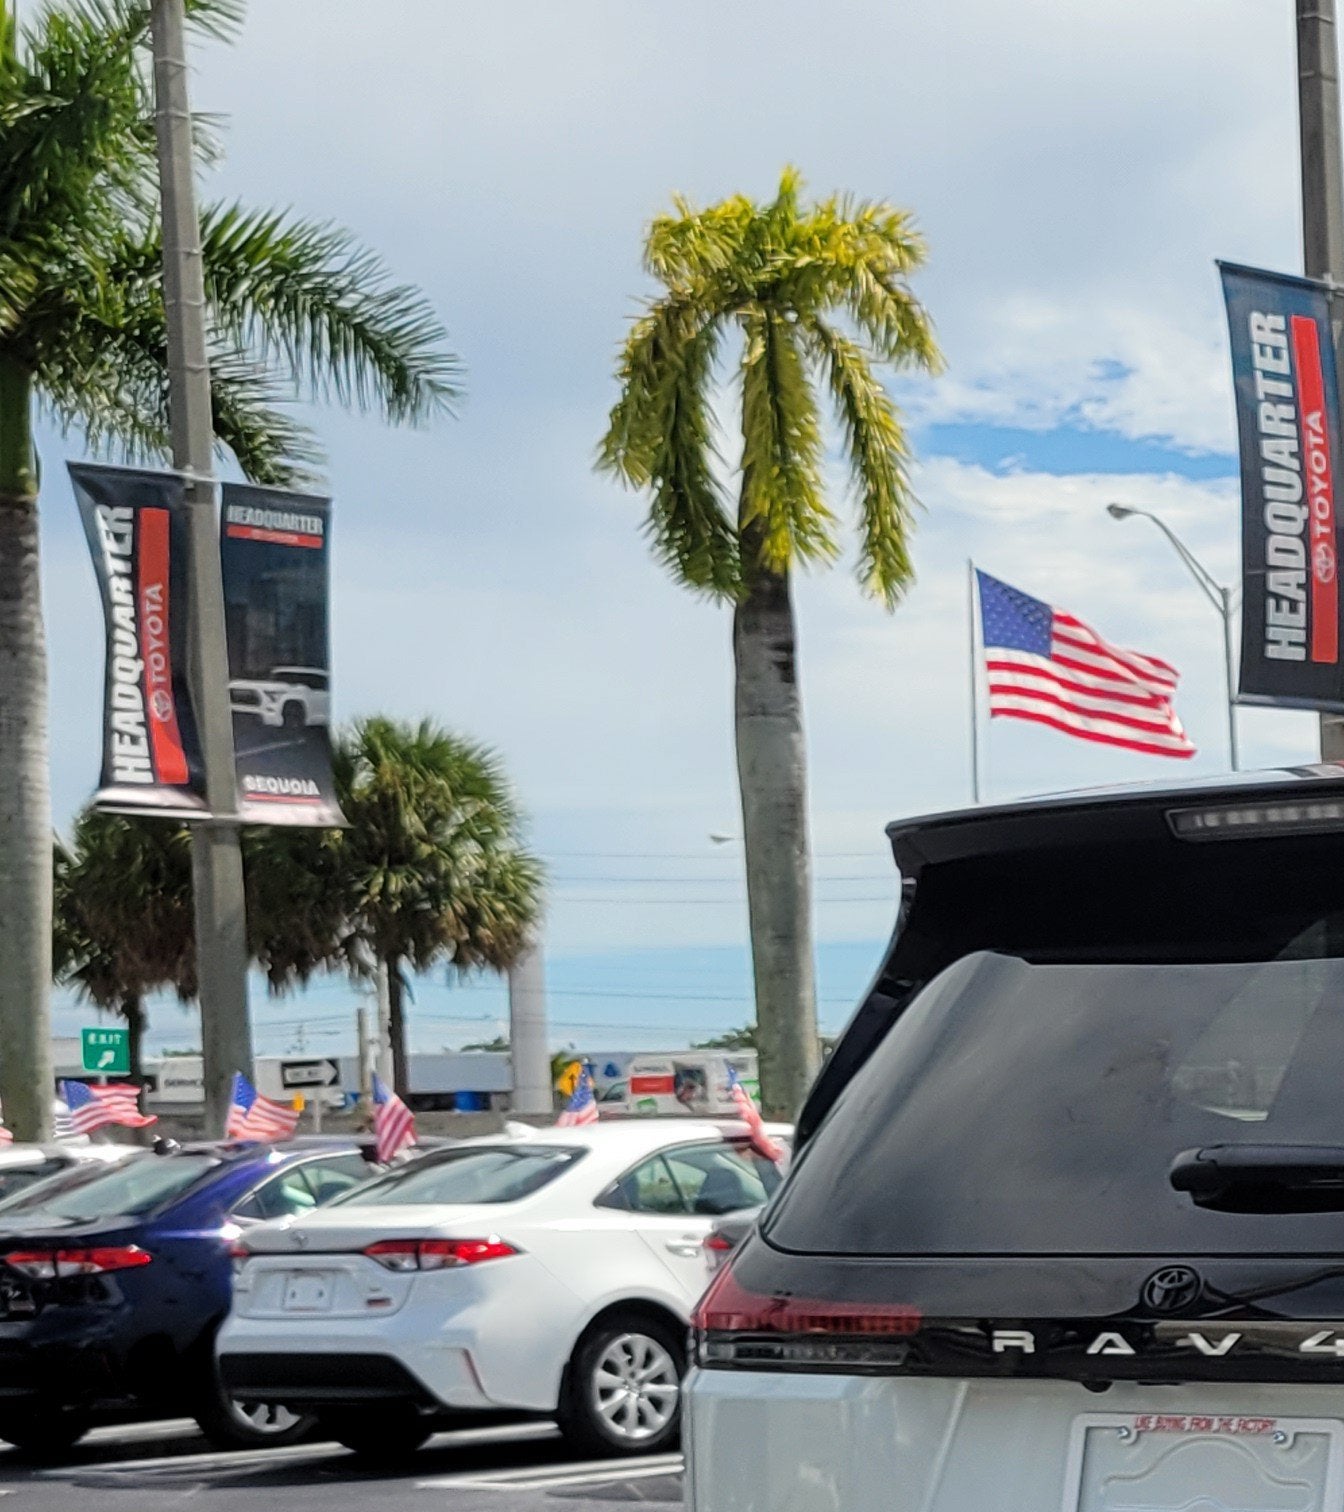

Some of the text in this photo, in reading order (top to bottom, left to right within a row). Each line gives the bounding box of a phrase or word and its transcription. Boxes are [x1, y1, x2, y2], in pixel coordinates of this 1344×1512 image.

[226, 504, 324, 535] HEADQUARTER
[1250, 310, 1308, 662] HEADQUARTER
[1304, 410, 1336, 538] TOYOTA
[95, 503, 154, 784] HEADQUARTER
[145, 583, 168, 685] TOYOTA
[243, 774, 321, 796] SEQUOIA
[88, 1033, 122, 1045] EXIT
